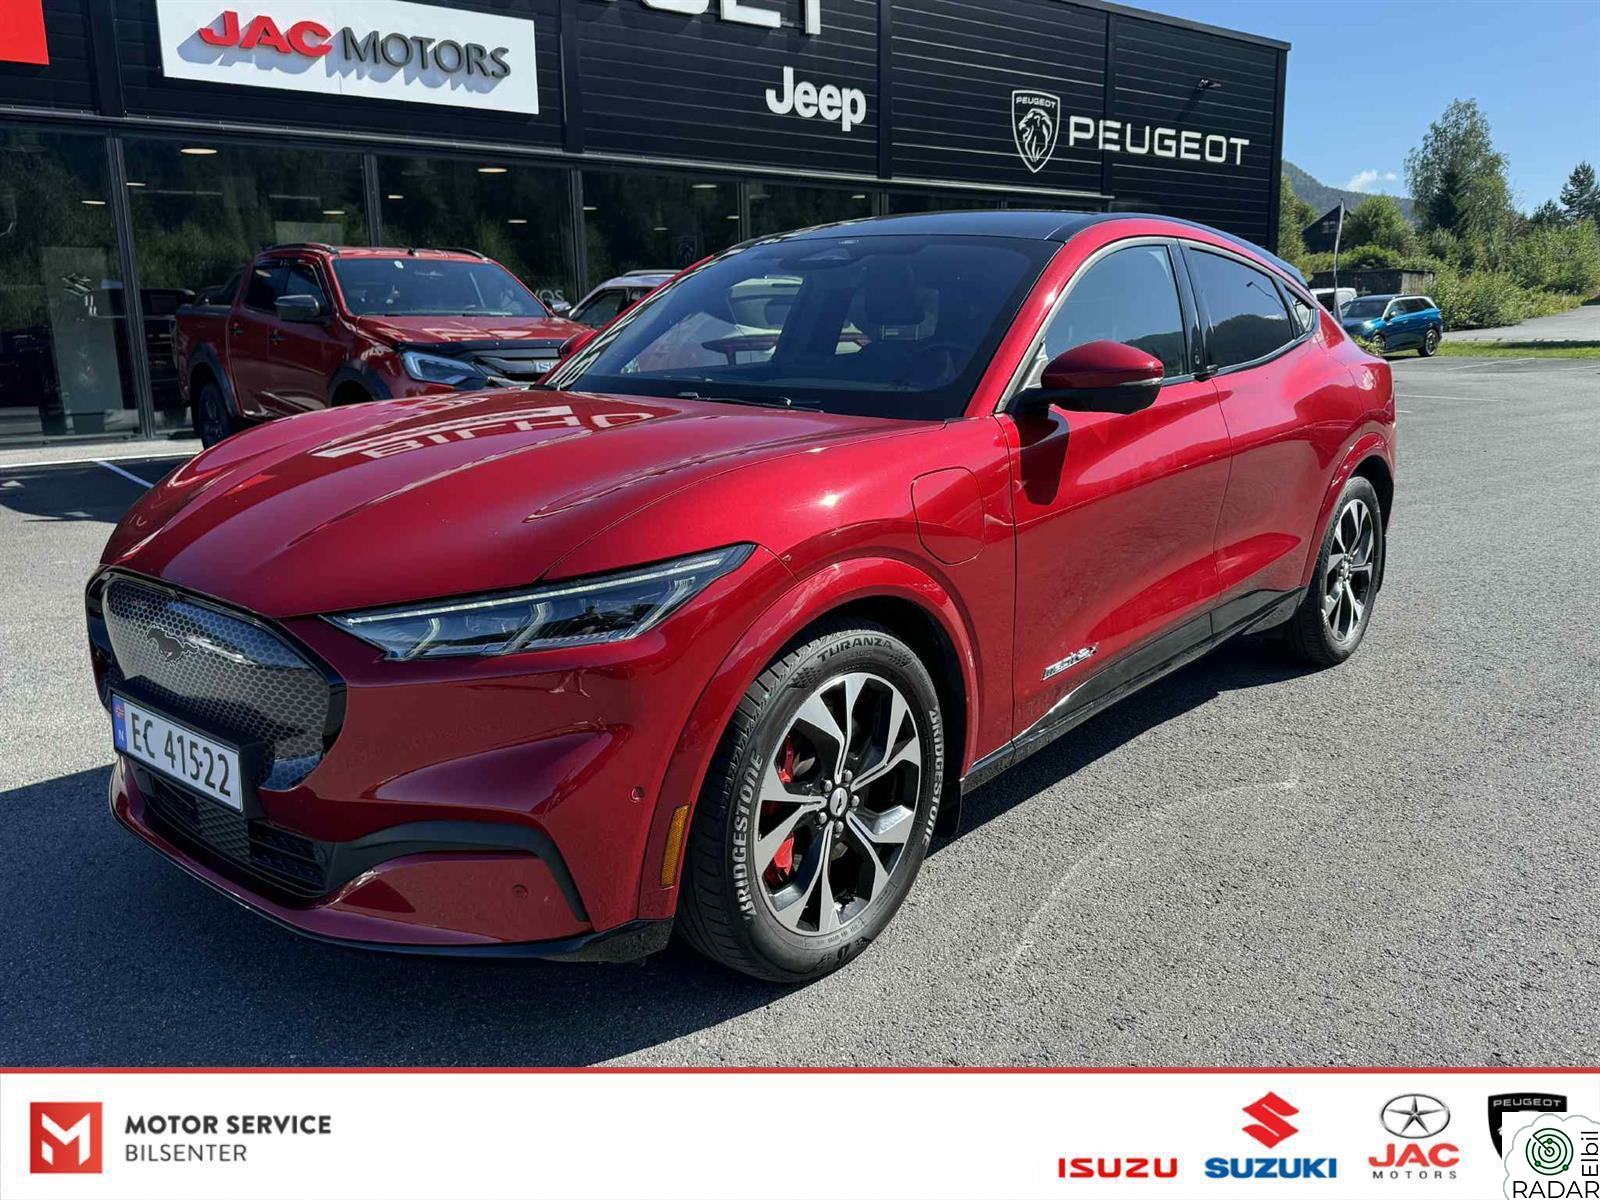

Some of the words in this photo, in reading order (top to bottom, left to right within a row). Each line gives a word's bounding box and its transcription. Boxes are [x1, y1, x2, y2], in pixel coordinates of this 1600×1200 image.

[198, 10, 333, 58] JAC
[342, 26, 511, 79] MOTORS
[765, 65, 867, 132] Jeep
[1016, 96, 1056, 109] PEUGEOT
[1069, 115, 1250, 165] PEUGEOT
[817, 637, 893, 662] TURANZA
[131, 712, 155, 759] EC
[164, 730, 231, 797] 41522
[922, 704, 944, 846] BRIDGESTONE
[732, 749, 764, 918] BRIDGESTONE
